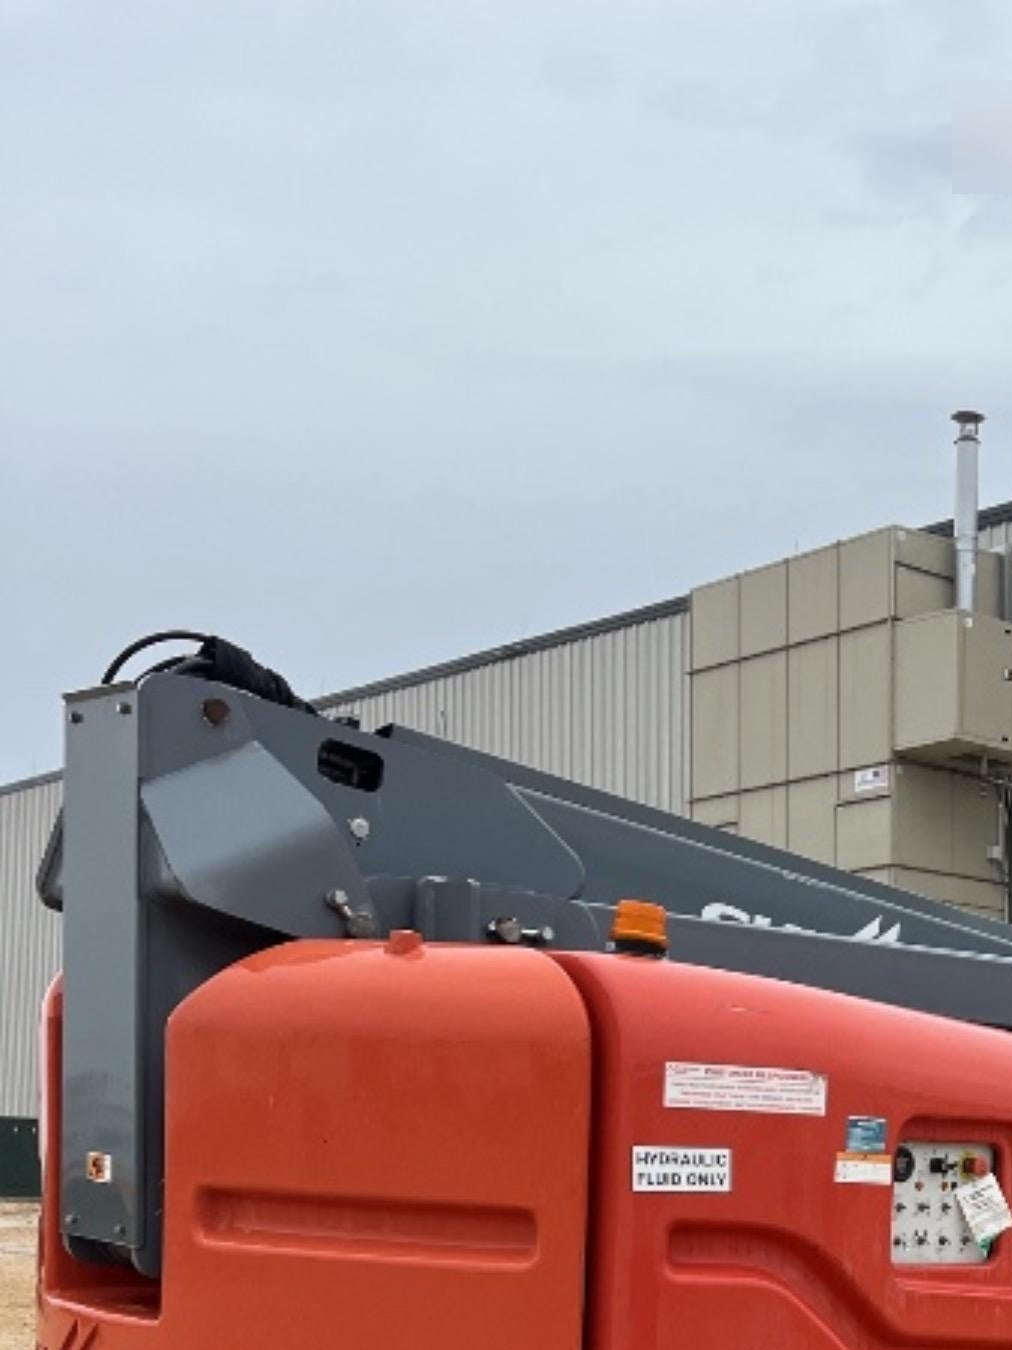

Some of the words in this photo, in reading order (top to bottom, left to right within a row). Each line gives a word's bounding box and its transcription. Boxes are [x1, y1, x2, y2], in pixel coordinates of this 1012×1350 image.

[636, 1151, 727, 1168] HYDRAULIC
[637, 1172, 681, 1187] FLUID
[686, 1172, 727, 1187] ONLY
